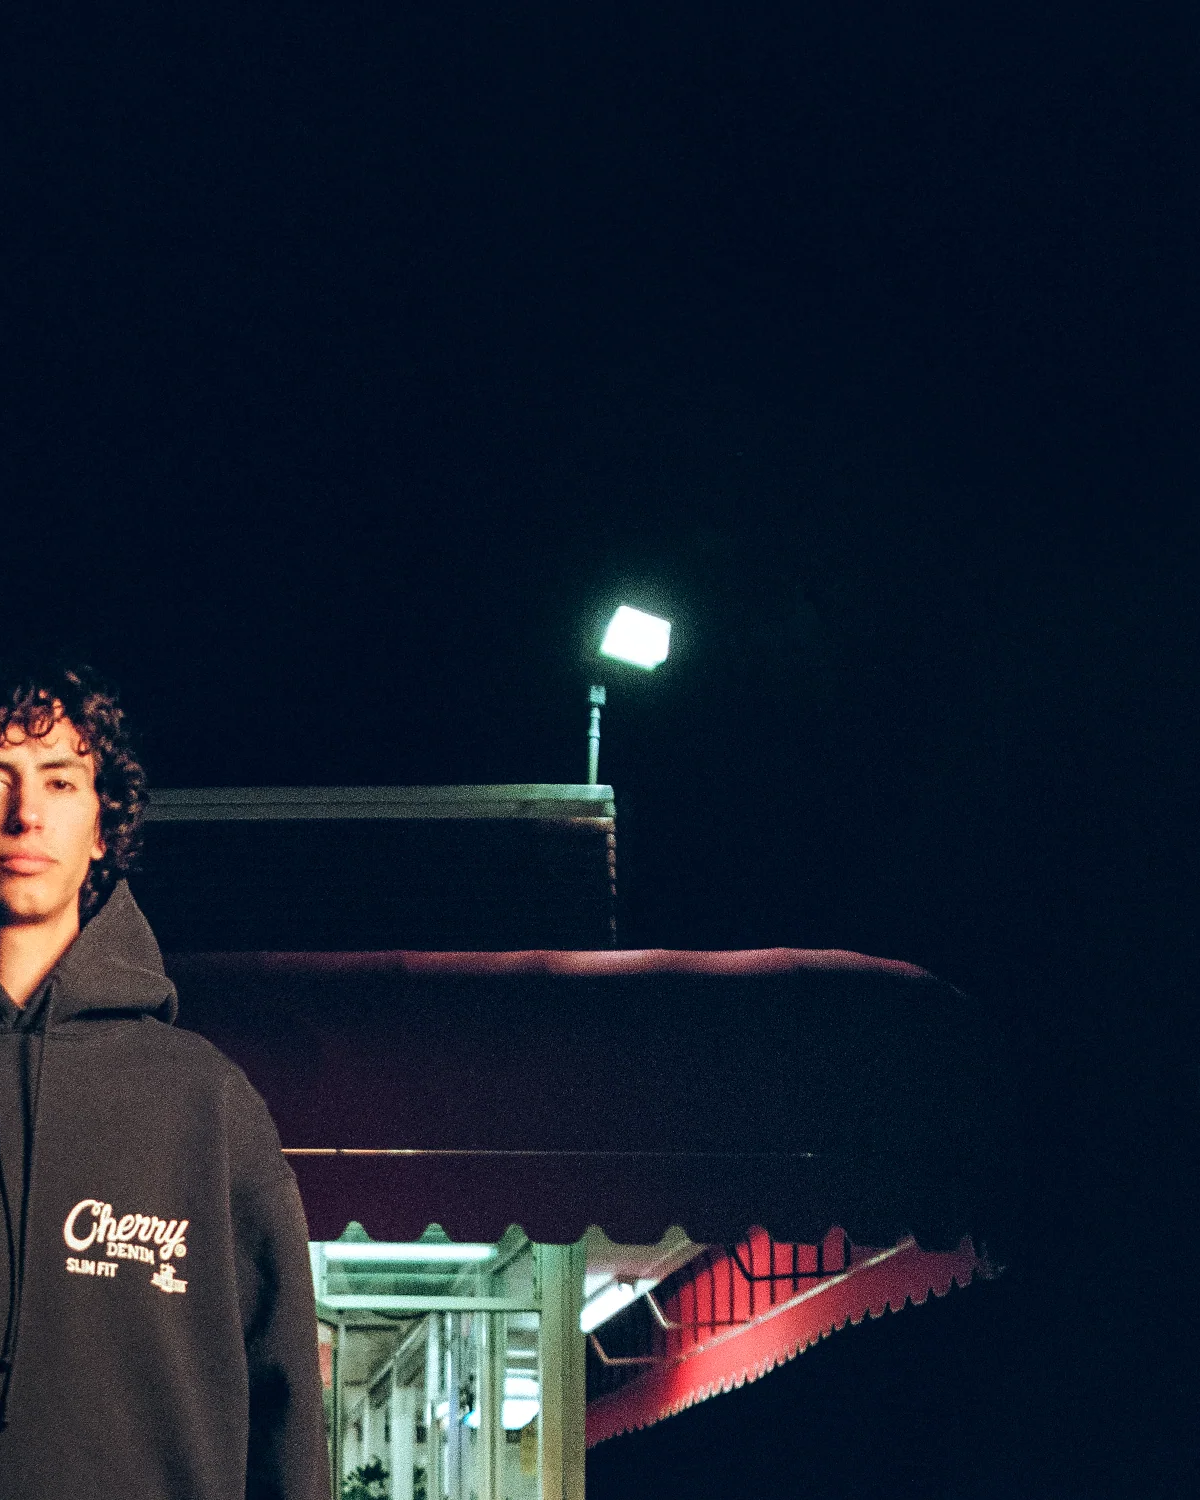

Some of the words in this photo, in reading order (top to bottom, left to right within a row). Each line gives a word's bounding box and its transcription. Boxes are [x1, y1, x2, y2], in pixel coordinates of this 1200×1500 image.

[63, 1199, 189, 1261] Cherry
[66, 1257, 95, 1276] SLIM
[96, 1261, 118, 1278] FIT
